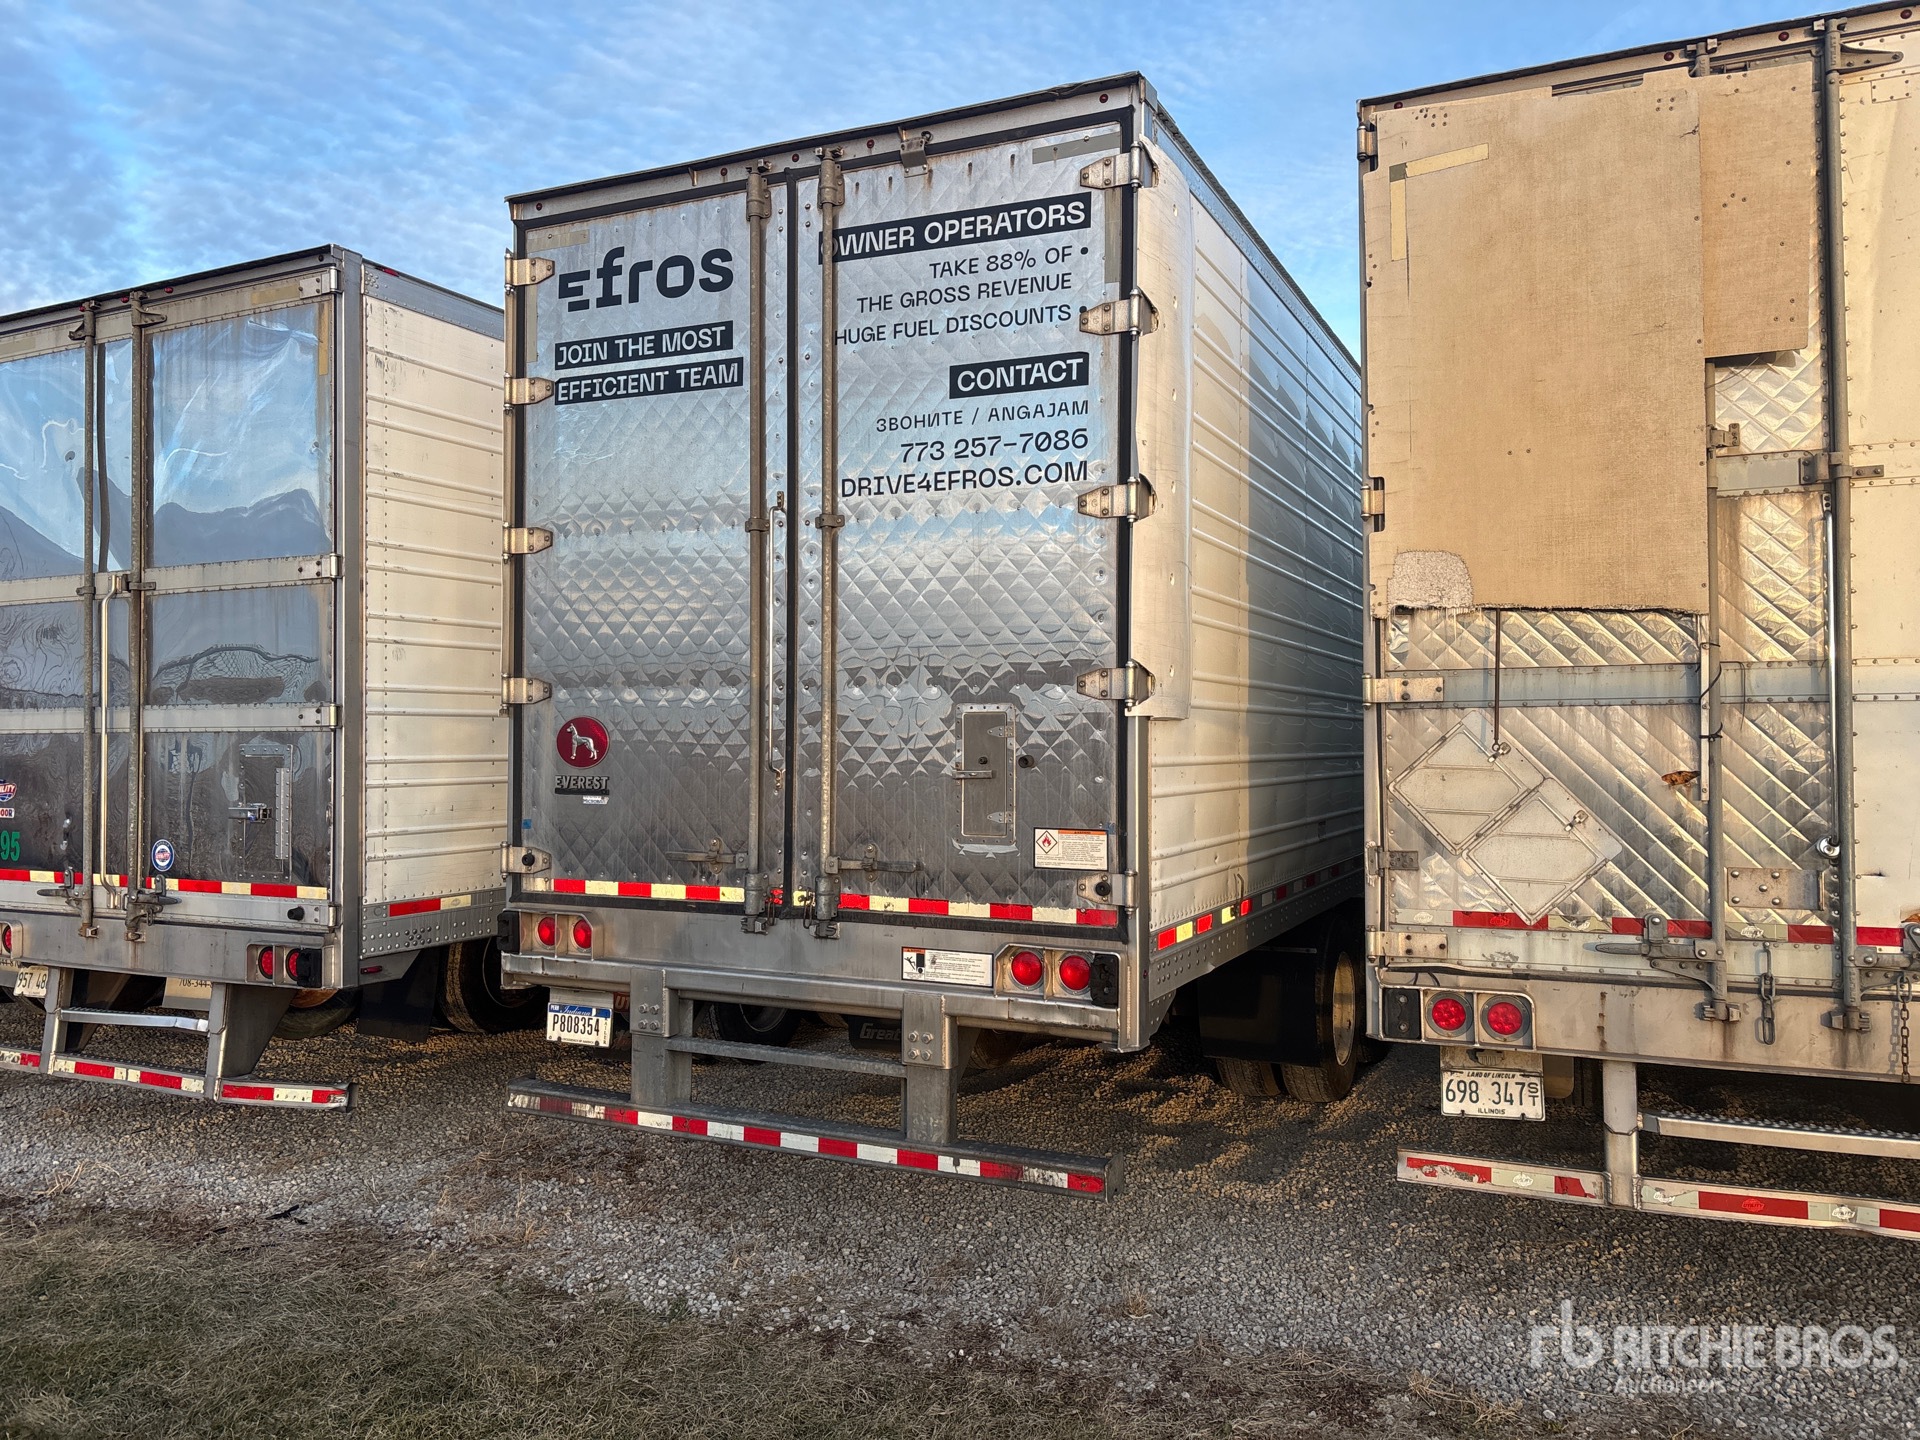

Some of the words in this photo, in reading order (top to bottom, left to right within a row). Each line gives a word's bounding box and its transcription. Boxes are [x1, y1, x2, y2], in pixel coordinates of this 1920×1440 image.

[923, 200, 1086, 244] OPERATORS
[929, 257, 979, 279] TAKE
[986, 249, 1036, 272] 88%
[1044, 245, 1073, 264] OF
[856, 294, 893, 313] THE
[899, 285, 971, 308] GROSS
[977, 272, 1072, 299] REVENUE
[834, 325, 887, 345] HUGE
[892, 319, 940, 339] FUEL
[945, 304, 1072, 334] DISCOUNTS
[557, 341, 608, 366] JOIN
[614, 335, 656, 358] THE
[662, 326, 726, 353] MOST
[558, 371, 670, 401] EFFICIENT
[676, 363, 739, 389] TEAM
[956, 358, 1084, 392] CONTACT
[876, 410, 963, 432] ЗВОНИТЕ
[987, 400, 1089, 422] ANGAJAM
[900, 440, 945, 463] 773
[954, 428, 1089, 459] 257-7086
[841, 460, 1088, 498] DRIVE4EFROS.COM
[555, 775, 609, 790] EVEREST
[17, 972, 33, 988] 957
[553, 1014, 600, 1036] P808354
[1445, 1079, 1480, 1103] 698
[1491, 1081, 1526, 1106] 347
[1478, 1107, 1506, 1115] ILLINOIS
